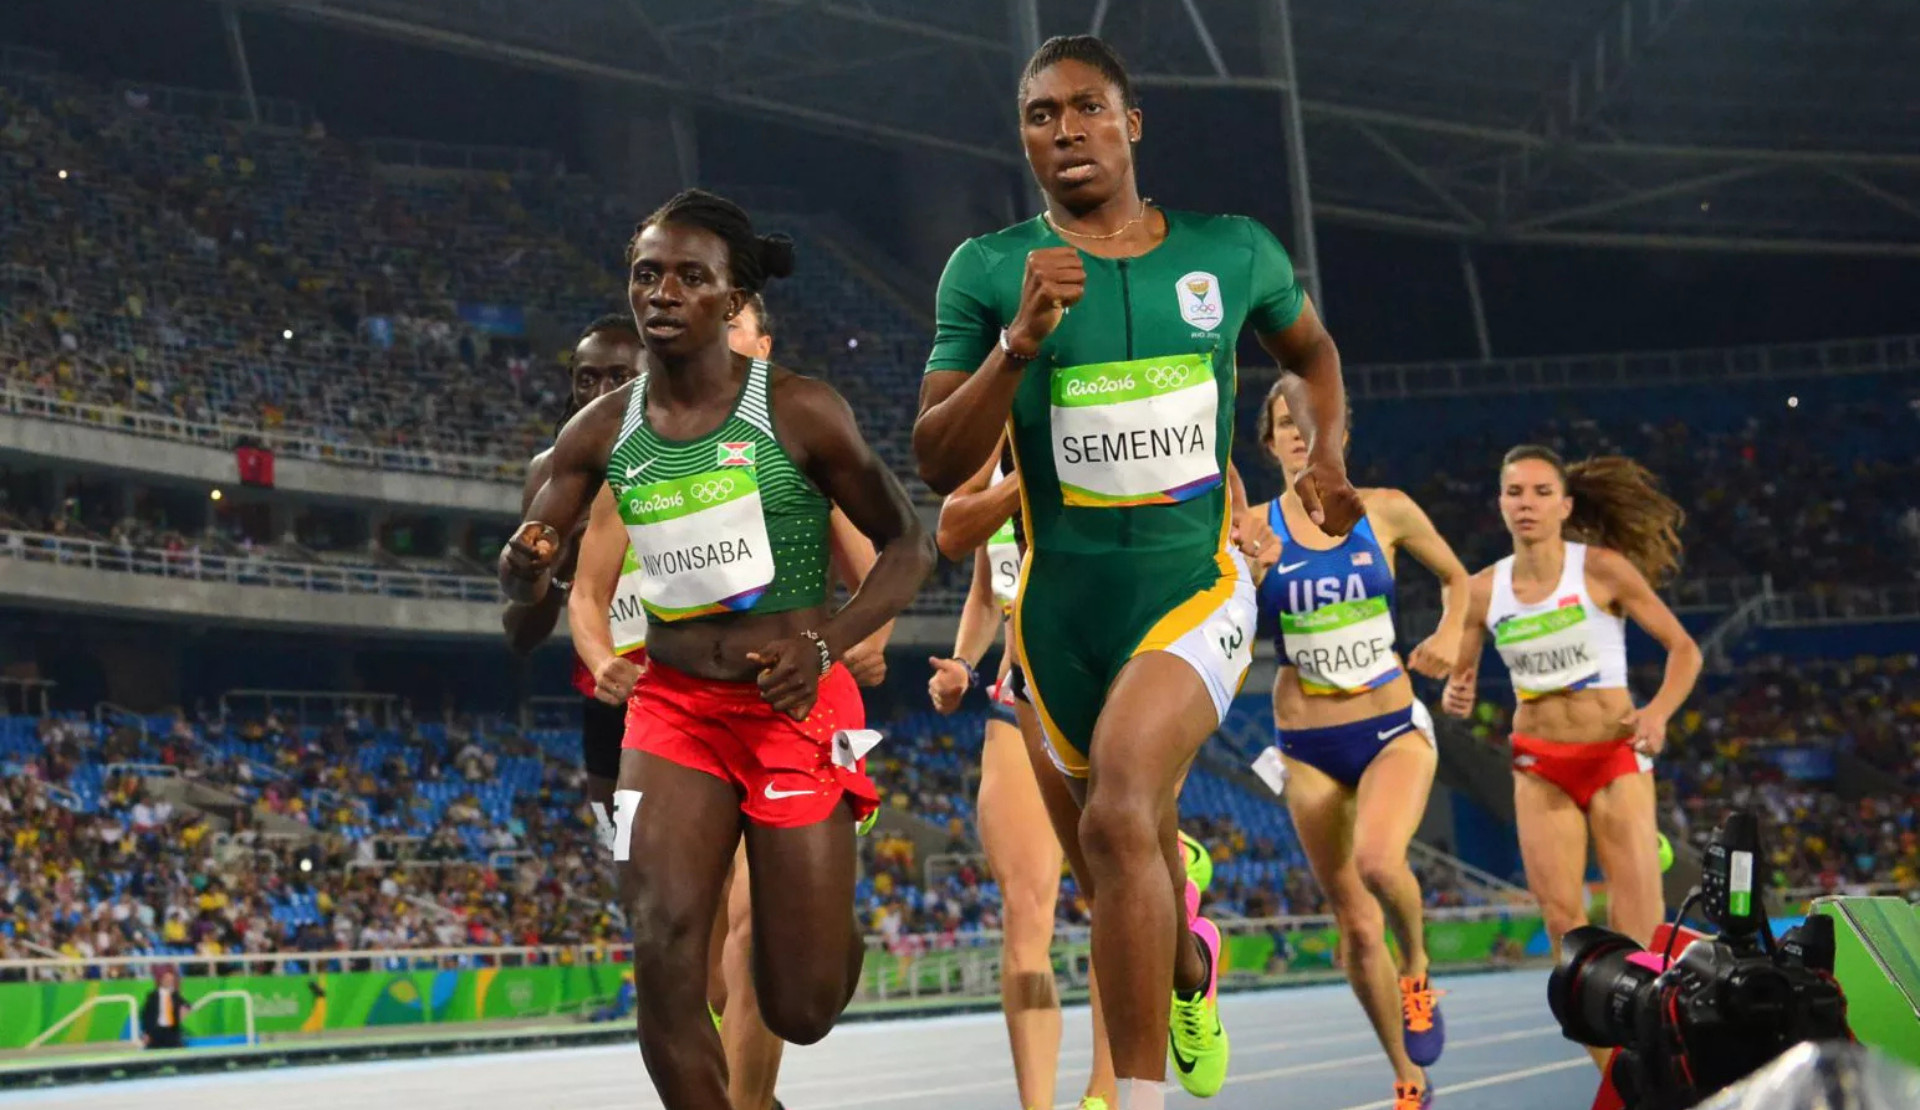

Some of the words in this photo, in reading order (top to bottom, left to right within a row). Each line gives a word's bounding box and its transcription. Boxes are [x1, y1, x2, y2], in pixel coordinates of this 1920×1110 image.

[1066, 374, 1135, 397] Rio2016
[1062, 424, 1205, 464] SEMENYA
[629, 490, 685, 515] Rio2016
[1289, 573, 1368, 615] USA
